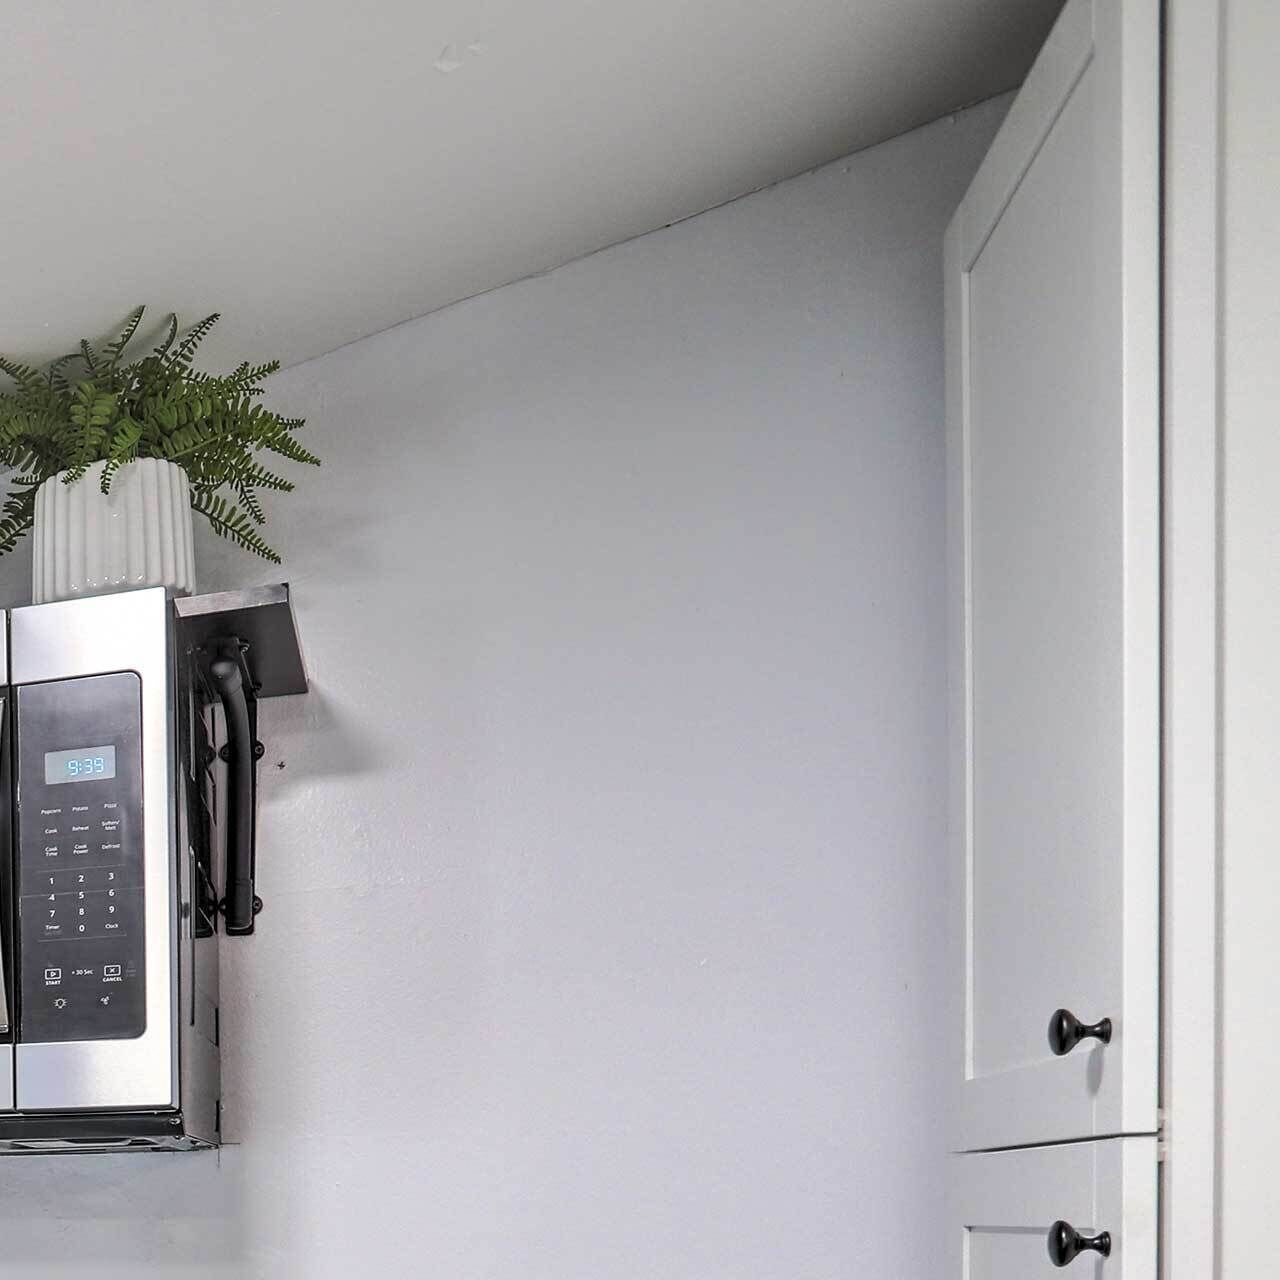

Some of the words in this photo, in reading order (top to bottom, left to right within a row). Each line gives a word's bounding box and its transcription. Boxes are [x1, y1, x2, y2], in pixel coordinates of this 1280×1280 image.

[68, 757, 104, 776] 9:39
[78, 874, 84, 883] 2
[108, 872, 114, 880] 3
[78, 891, 84, 899] 5
[108, 889, 115, 897] 6
[79, 908, 85, 916] 8
[108, 905, 115, 913] 9
[49, 910, 56, 918] 7
[79, 924, 85, 932] 0
